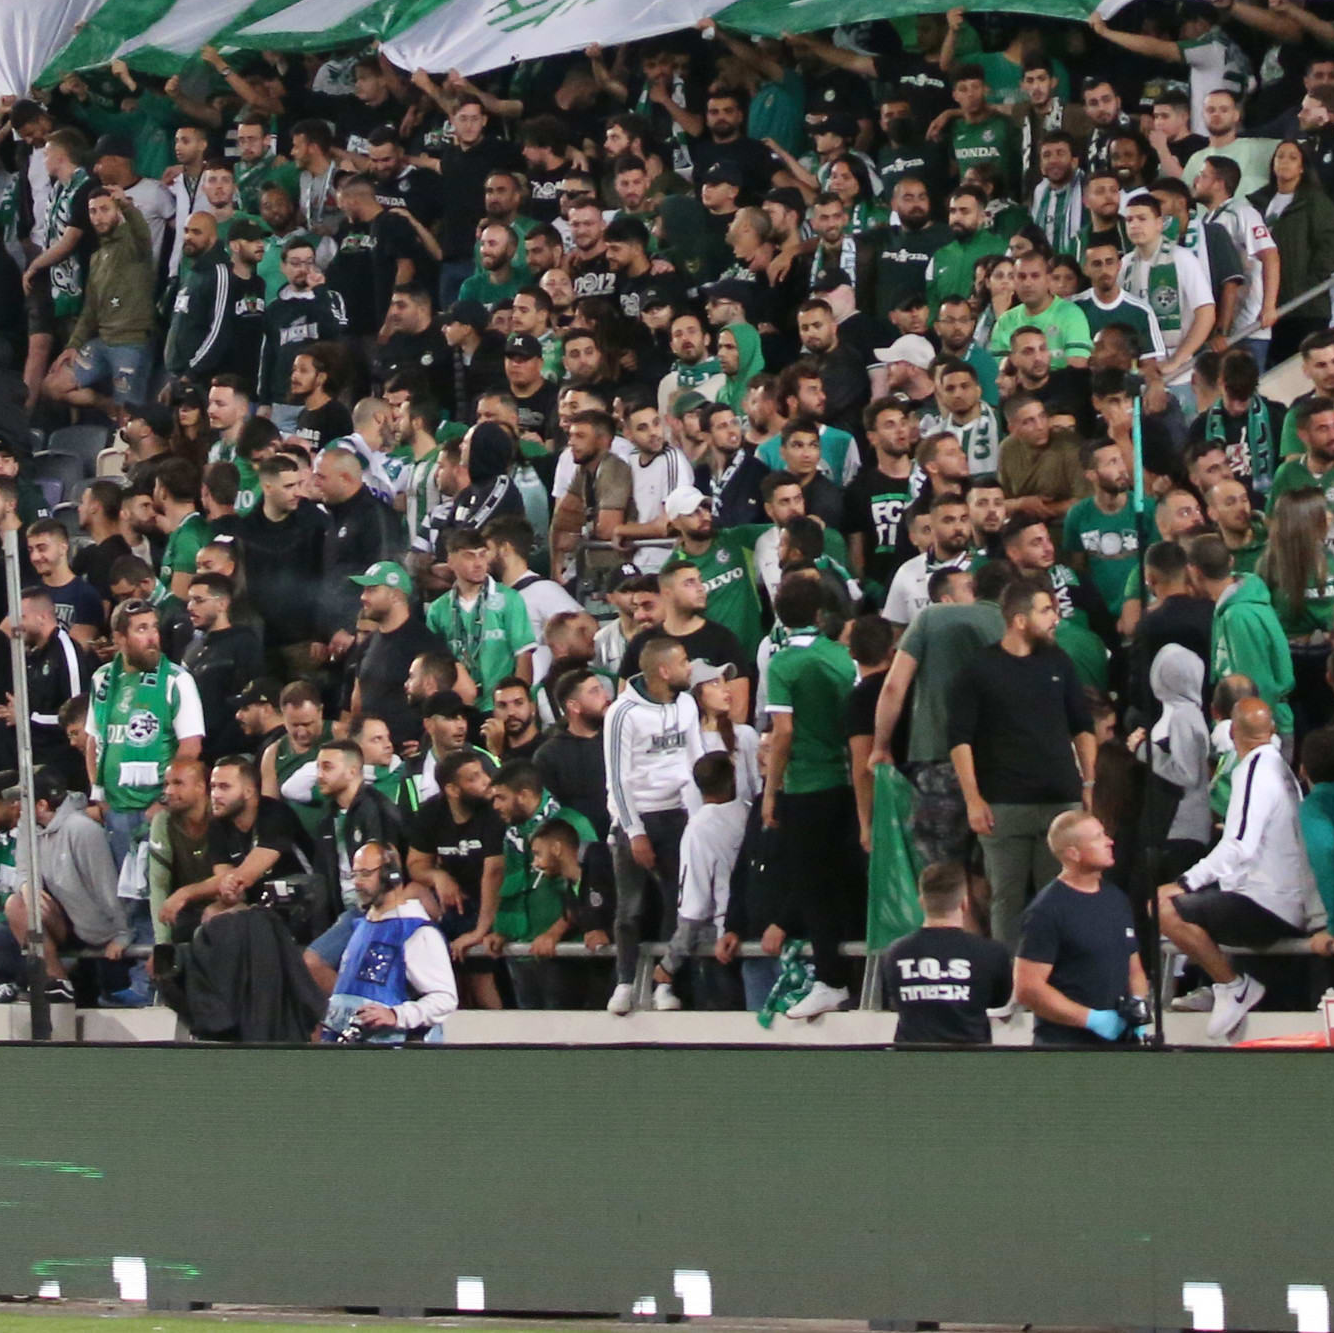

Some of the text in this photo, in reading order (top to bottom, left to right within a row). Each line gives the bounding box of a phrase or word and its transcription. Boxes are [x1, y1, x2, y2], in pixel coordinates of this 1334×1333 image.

[955, 147, 1000, 159] HONDA
[896, 958, 971, 981] T.Q.S
[899, 985, 971, 1002] אבטחה
